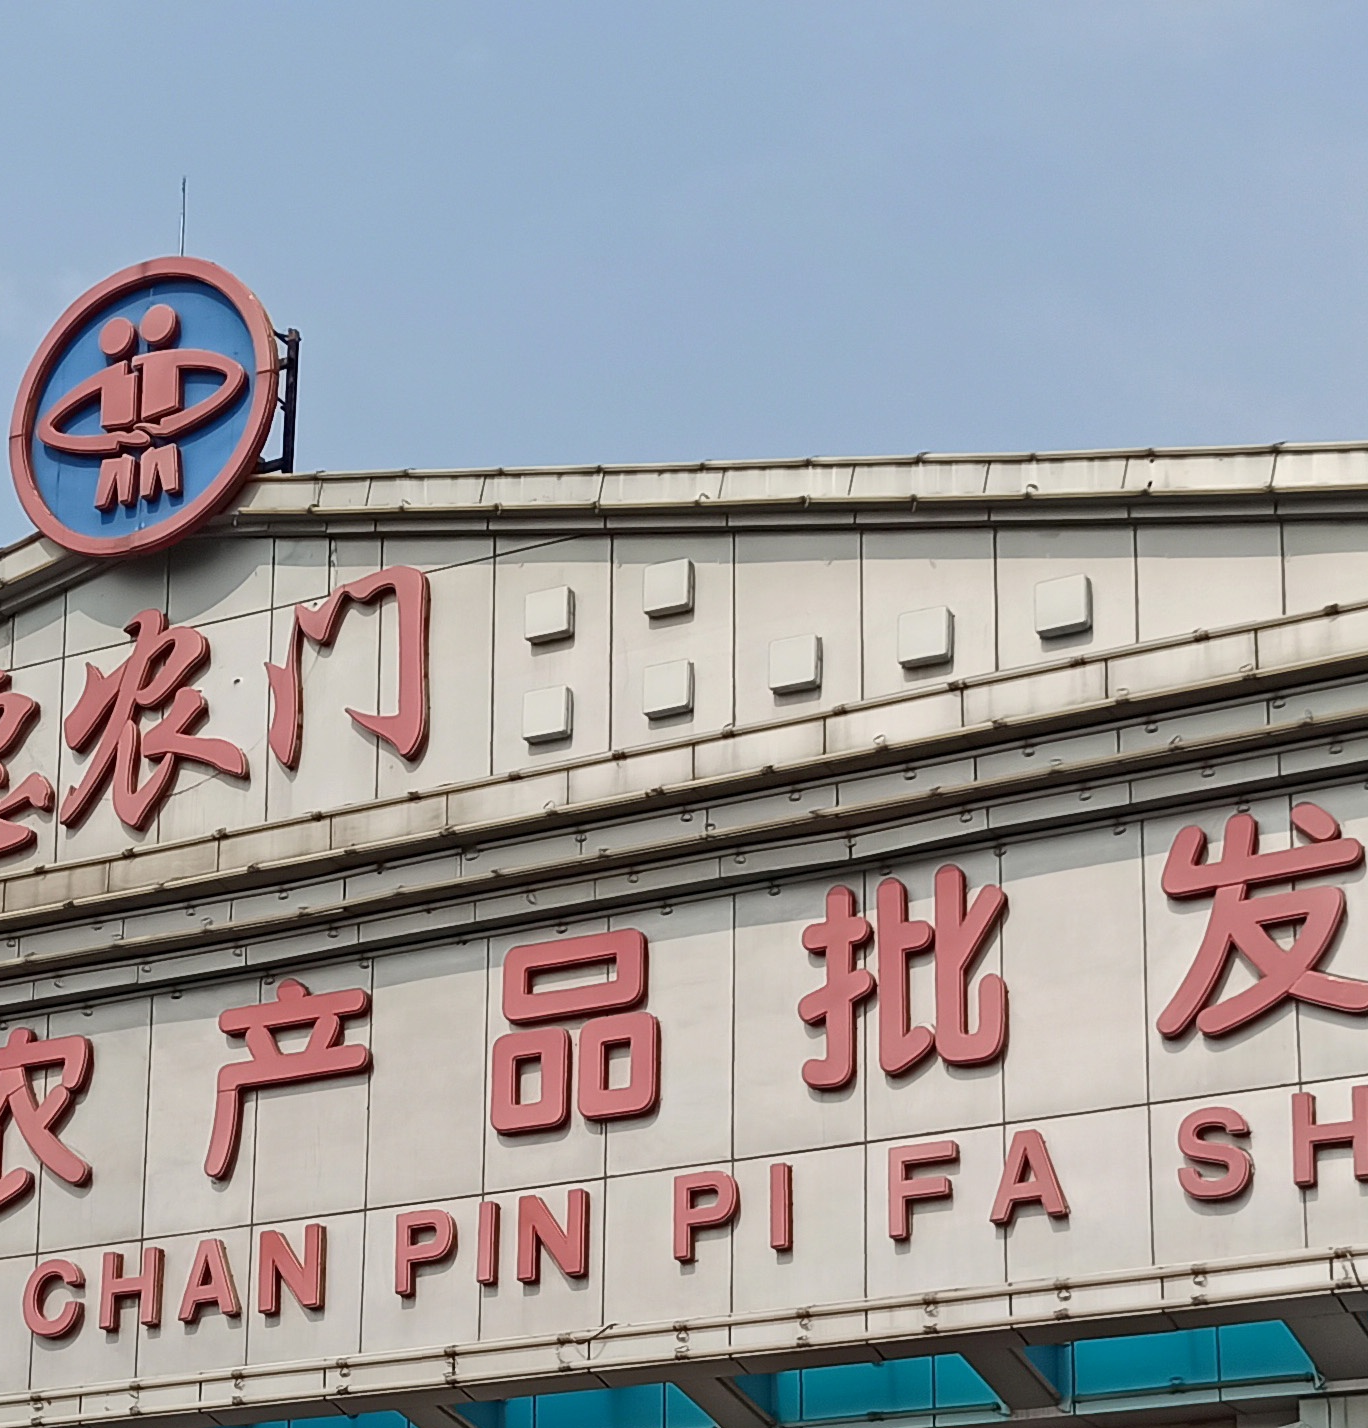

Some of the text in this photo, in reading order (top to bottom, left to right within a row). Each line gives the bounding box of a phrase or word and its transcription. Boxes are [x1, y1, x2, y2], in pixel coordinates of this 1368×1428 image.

[22, 1222, 327, 1339] CHAN
[394, 1188, 592, 1297] PIN
[672, 1162, 795, 1263] PI
[887, 1128, 1071, 1241] FA
